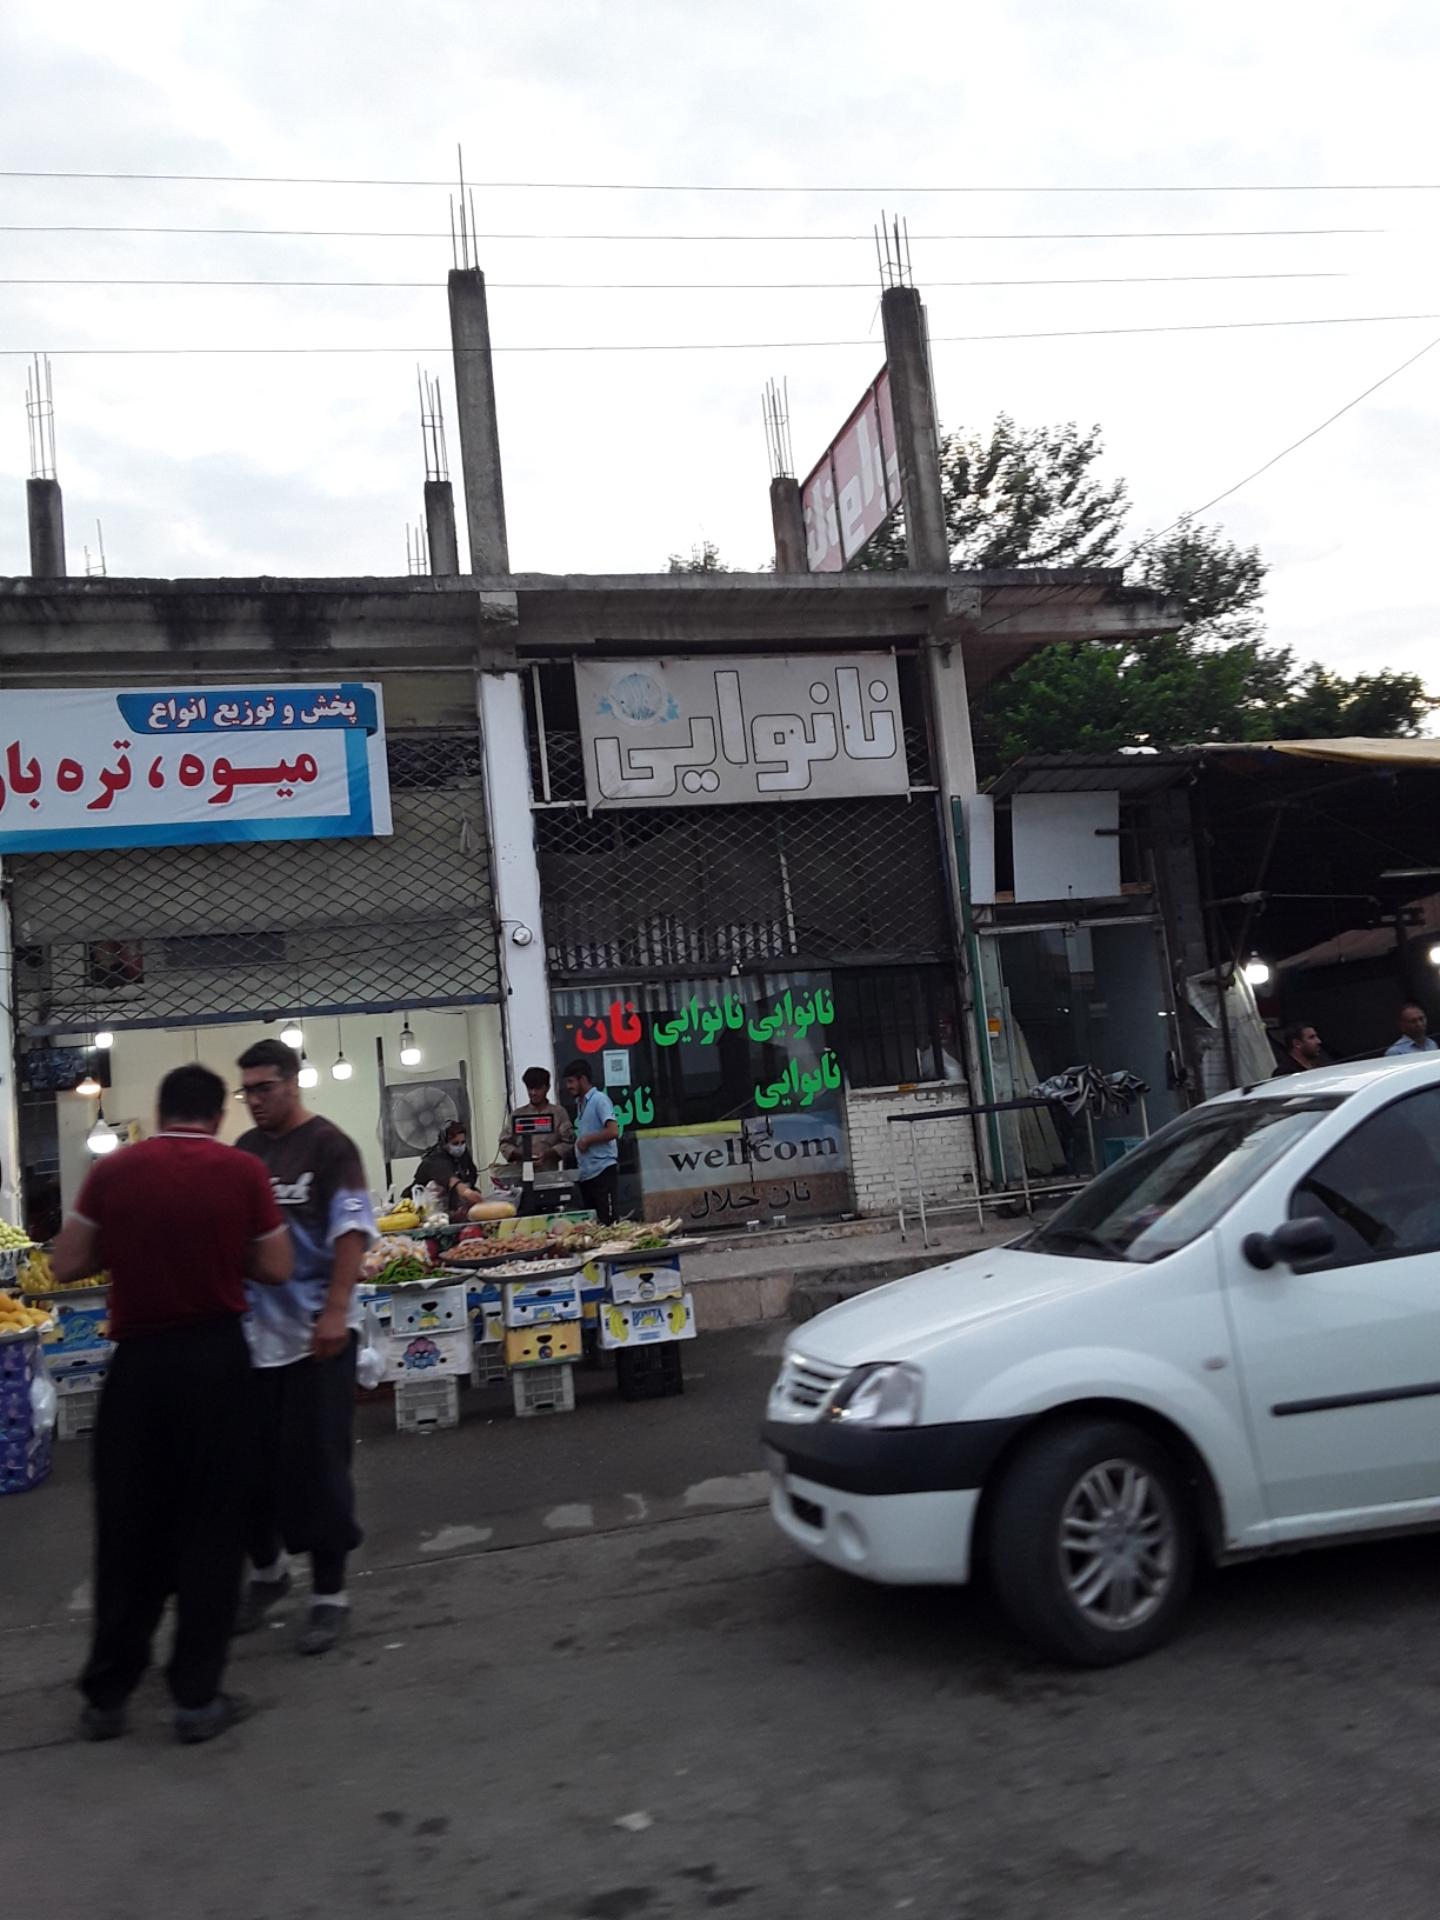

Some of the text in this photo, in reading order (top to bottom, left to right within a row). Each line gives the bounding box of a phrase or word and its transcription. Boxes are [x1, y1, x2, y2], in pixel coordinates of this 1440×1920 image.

[147, 694, 357, 729] پخش و توزیع انواع
[594, 666, 898, 801] نانوایی
[0, 739, 42, 813] با
[56, 739, 132, 811] تره
[575, 1000, 643, 1054] نان
[653, 988, 836, 1047] نانوایی نانوایی
[668, 1134, 839, 1173] wellcom
[690, 1180, 812, 1220] نان حلال
